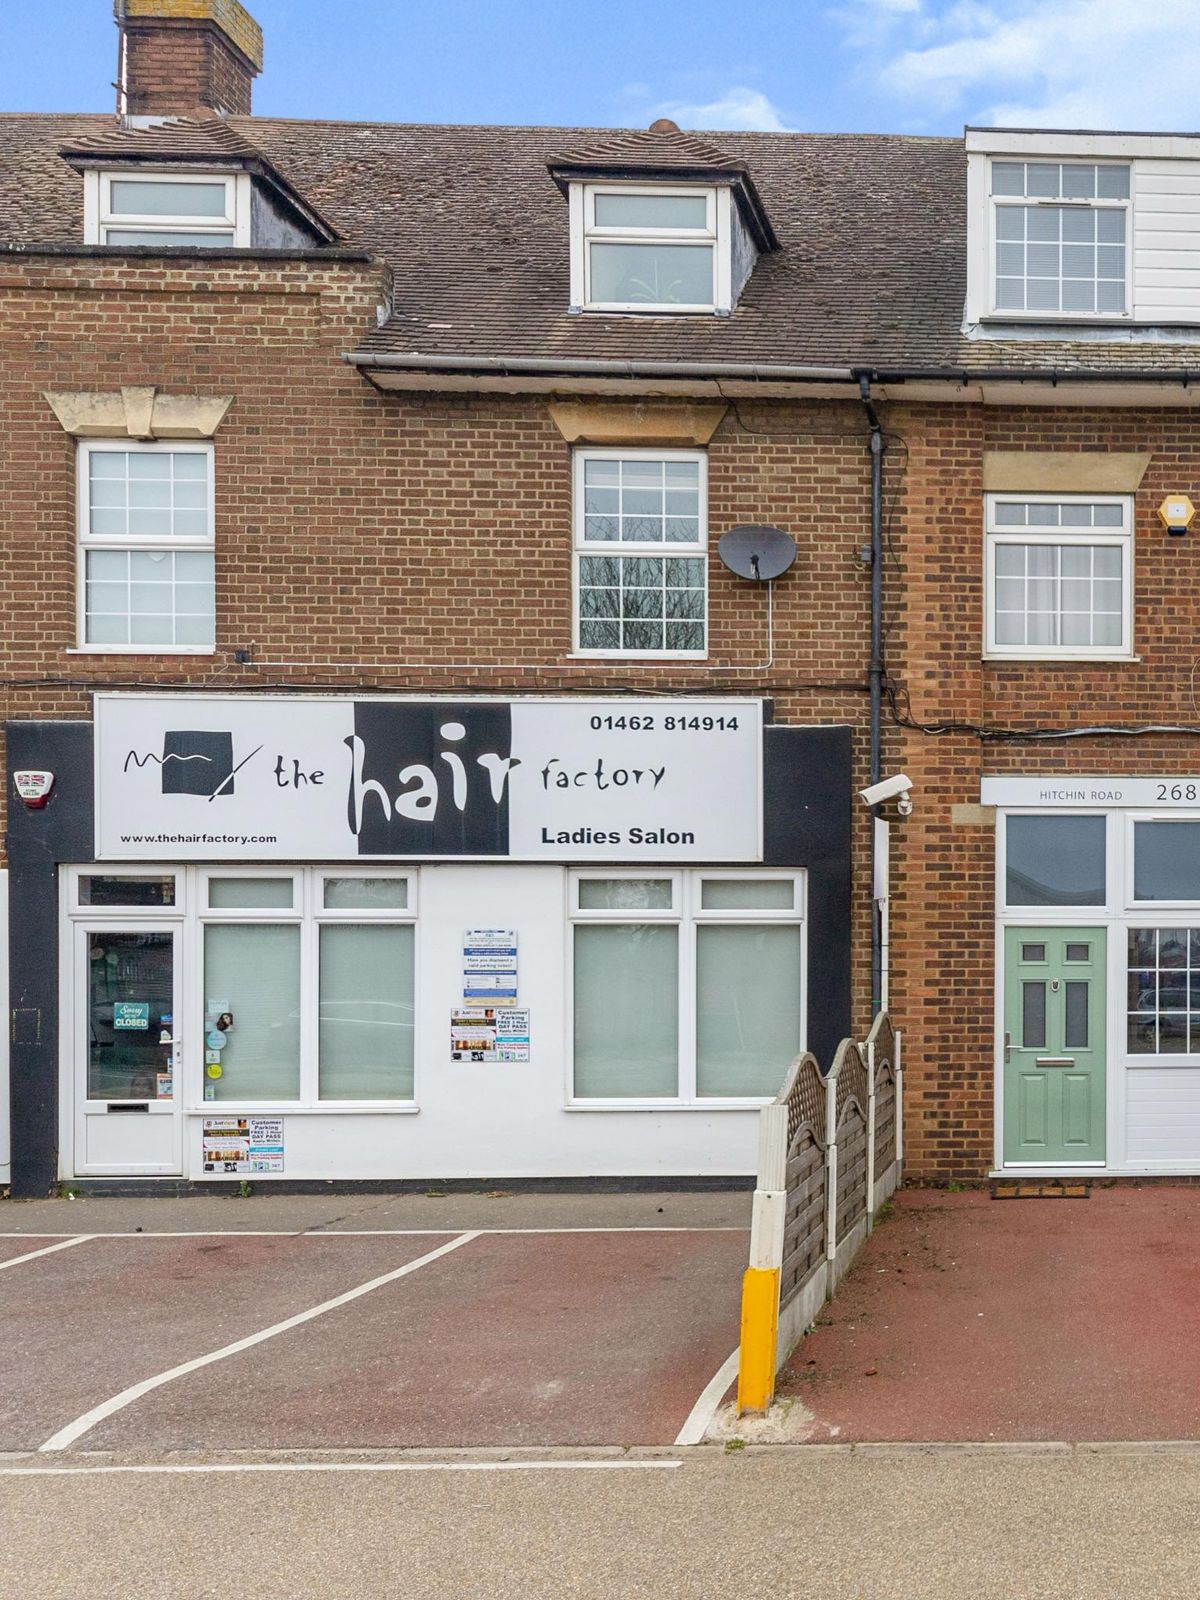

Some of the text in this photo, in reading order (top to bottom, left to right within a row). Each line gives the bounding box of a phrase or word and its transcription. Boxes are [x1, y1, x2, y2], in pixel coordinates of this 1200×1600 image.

[590, 716, 739, 731] 01462 814914
[274, 722, 665, 835] the hair factory
[1040, 791, 1085, 800] HITCHIN
[1091, 791, 1122, 800] ROAD
[1156, 784, 1197, 801] 268
[120, 833, 277, 846] www.thehairfactory.com
[541, 827, 695, 845] Ladies Salon
[115, 1018, 147, 1027] CLOSED
